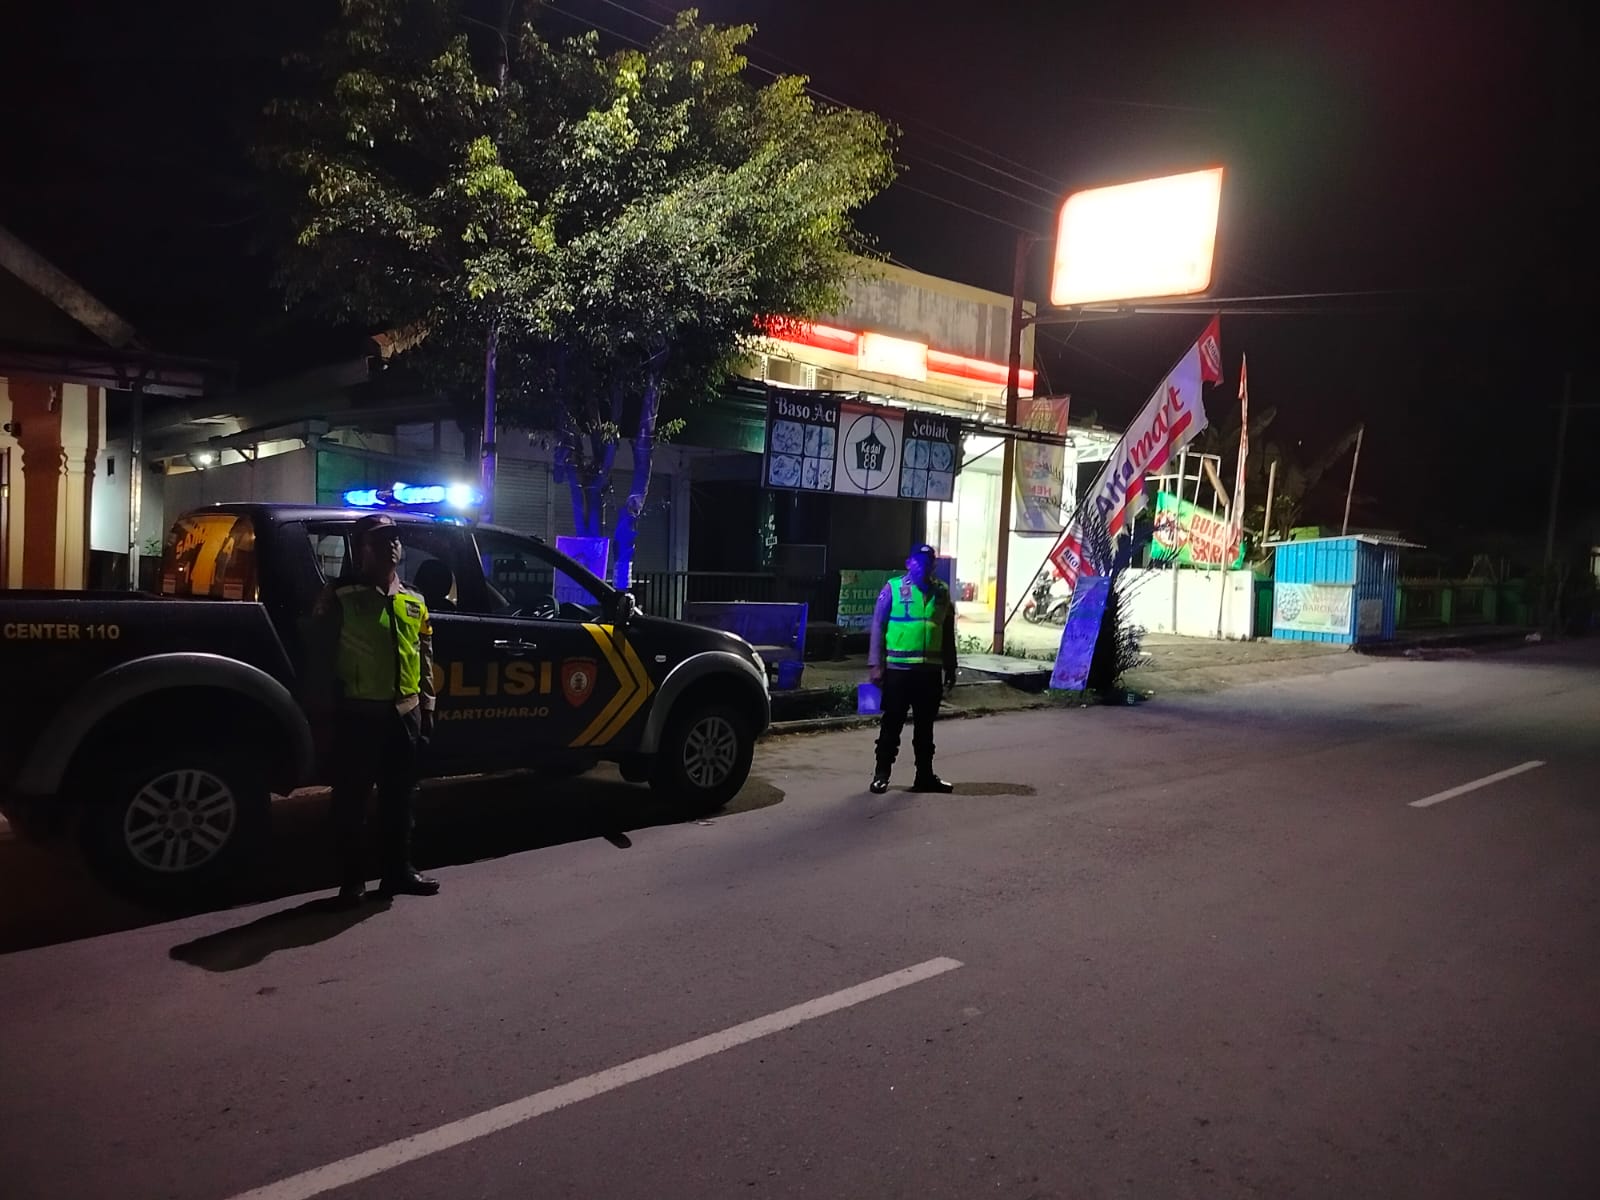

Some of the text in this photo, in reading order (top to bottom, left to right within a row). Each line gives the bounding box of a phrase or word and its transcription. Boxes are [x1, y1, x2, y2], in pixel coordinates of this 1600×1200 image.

[775, 397, 837, 423] Baso Aci
[912, 418, 950, 443] Seblak
[864, 454, 877, 469] 88
[1096, 386, 1184, 519] Alfamart
[4, 623, 120, 639] CENTER 110
[438, 706, 549, 721] KARTOHARJO
